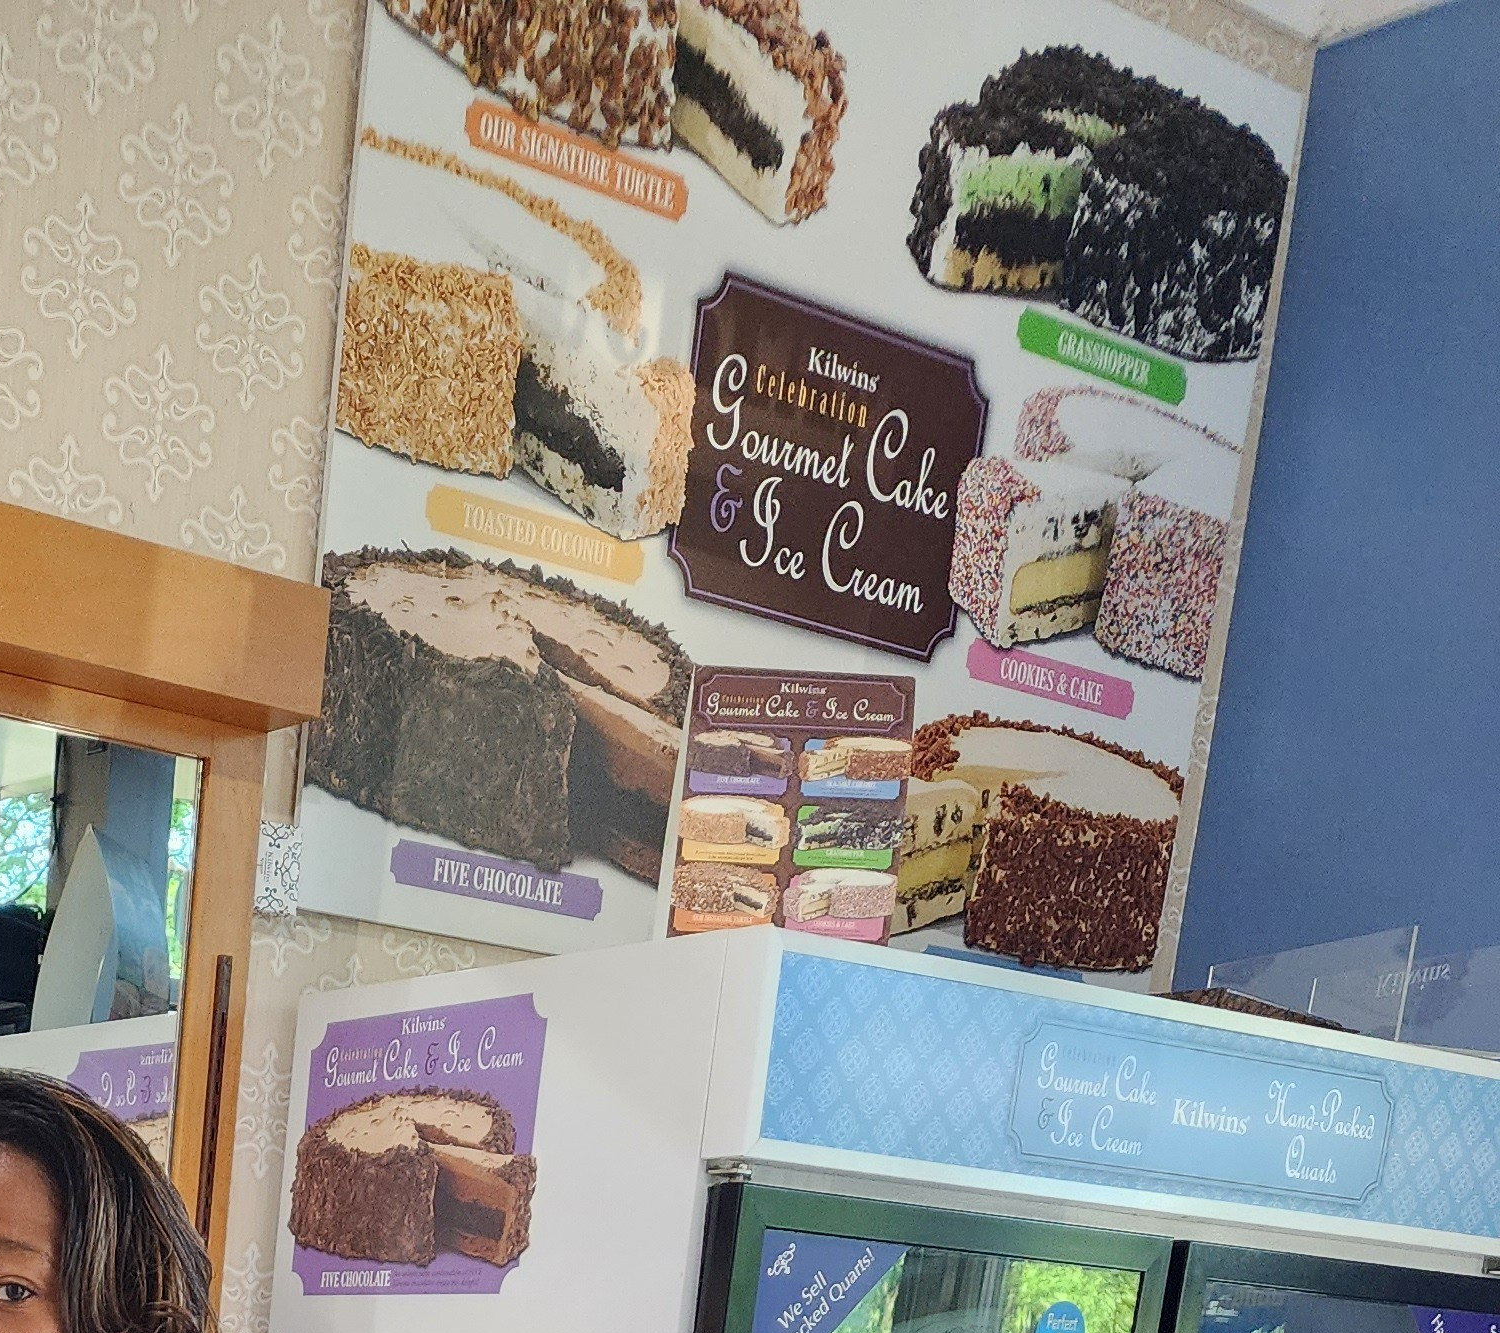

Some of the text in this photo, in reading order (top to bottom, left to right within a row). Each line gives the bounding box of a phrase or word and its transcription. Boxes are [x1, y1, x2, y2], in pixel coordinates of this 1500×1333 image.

[480, 112, 675, 211] OUR SIGNATURE TURTLE
[807, 346, 880, 393] Kilwins
[1058, 329, 1150, 386] GRASSHOPPER
[756, 363, 867, 429] Celebration
[706, 354, 949, 519] Gourmet Cake
[463, 501, 615, 567] TOASTED COCONUT
[710, 463, 923, 613] & Ice Cream
[706, 693, 896, 722] Gourmet Cake & Ice Cream
[1001, 657, 1104, 706] COOKIES & CAKE
[433, 857, 563, 906] FIVE CHOCOLATE
[401, 1015, 447, 1035] Kilwins
[324, 1025, 524, 1088] Gourmet Cake & Ice Cream
[1037, 1041, 1157, 1106] Gourmet Cake
[1038, 1098, 1143, 1156] & Ice Cream
[1171, 1098, 1251, 1135] Kilwins
[1264, 1079, 1375, 1140] Hand-Packed
[1285, 1134, 1337, 1184] Quarts
[320, 1271, 340, 1288] FIVE
[341, 1270, 392, 1288] CHOCOLATE
[777, 1271, 828, 1329] We Sell
[829, 1247, 877, 1302] Quarts!
[1046, 1313, 1078, 1331] Perfect
